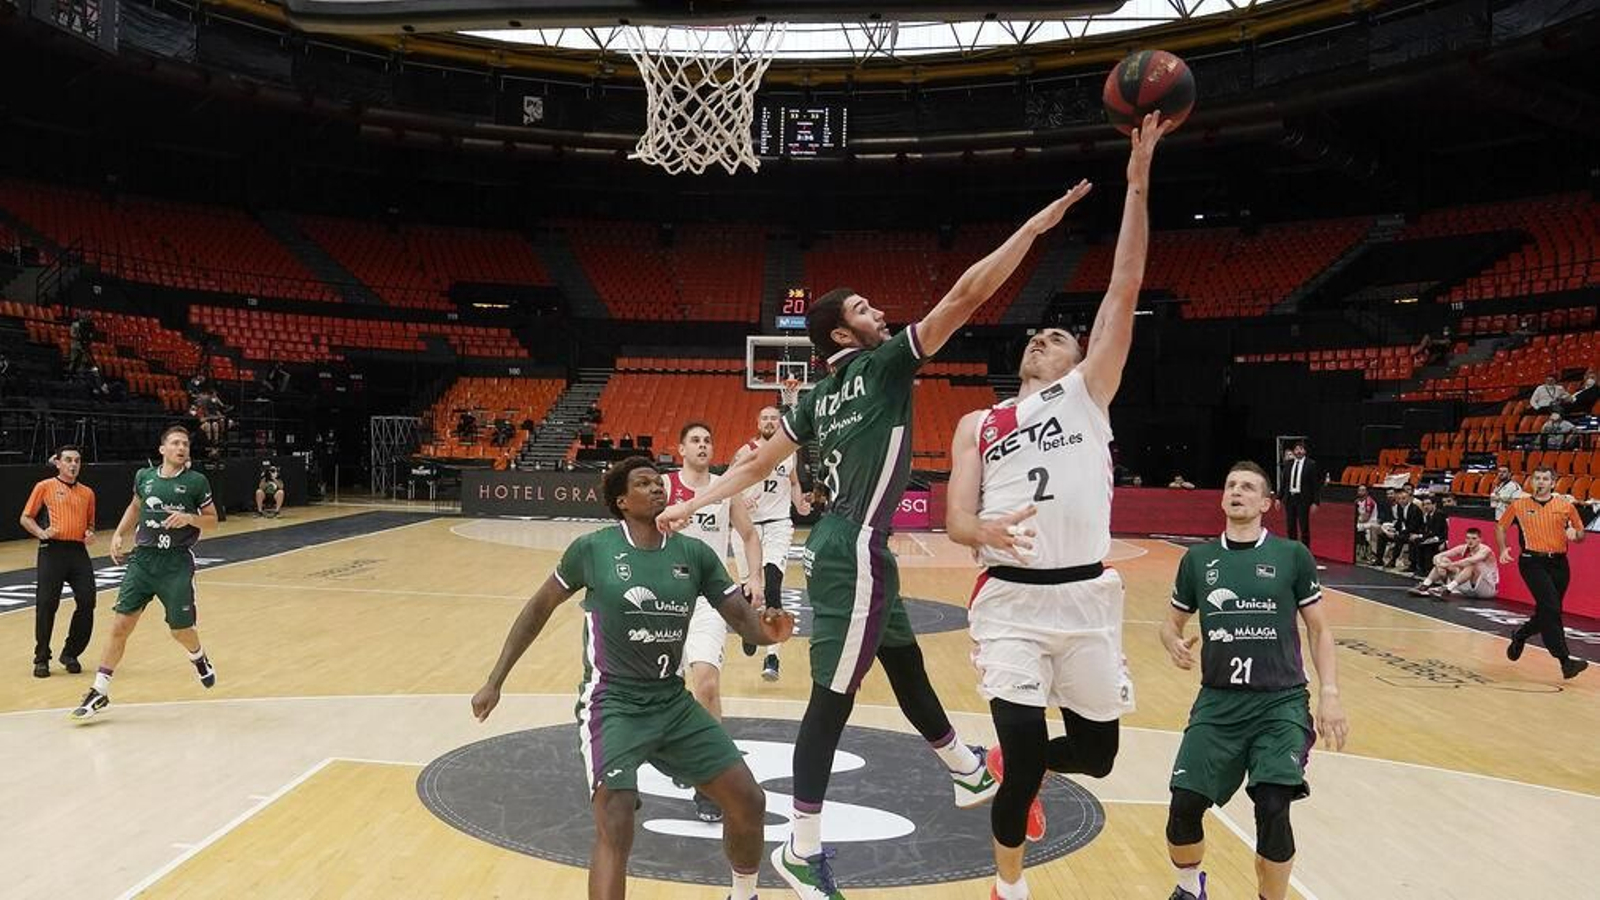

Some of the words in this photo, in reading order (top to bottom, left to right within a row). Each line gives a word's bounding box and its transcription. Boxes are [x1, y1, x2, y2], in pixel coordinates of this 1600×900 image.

[782, 299, 805, 314] 20
[985, 416, 1063, 464] RETA
[1043, 432, 1083, 451] bet.es
[479, 484, 545, 500] HOTEL
[554, 486, 598, 502] GRA
[763, 480, 778, 494] 12
[1028, 467, 1055, 503] 2
[895, 498, 928, 513] sa
[1235, 598, 1278, 612] Unicaja
[1235, 624, 1278, 636] MÁLAGA
[657, 653, 670, 679] 2
[1230, 656, 1254, 685] 21
